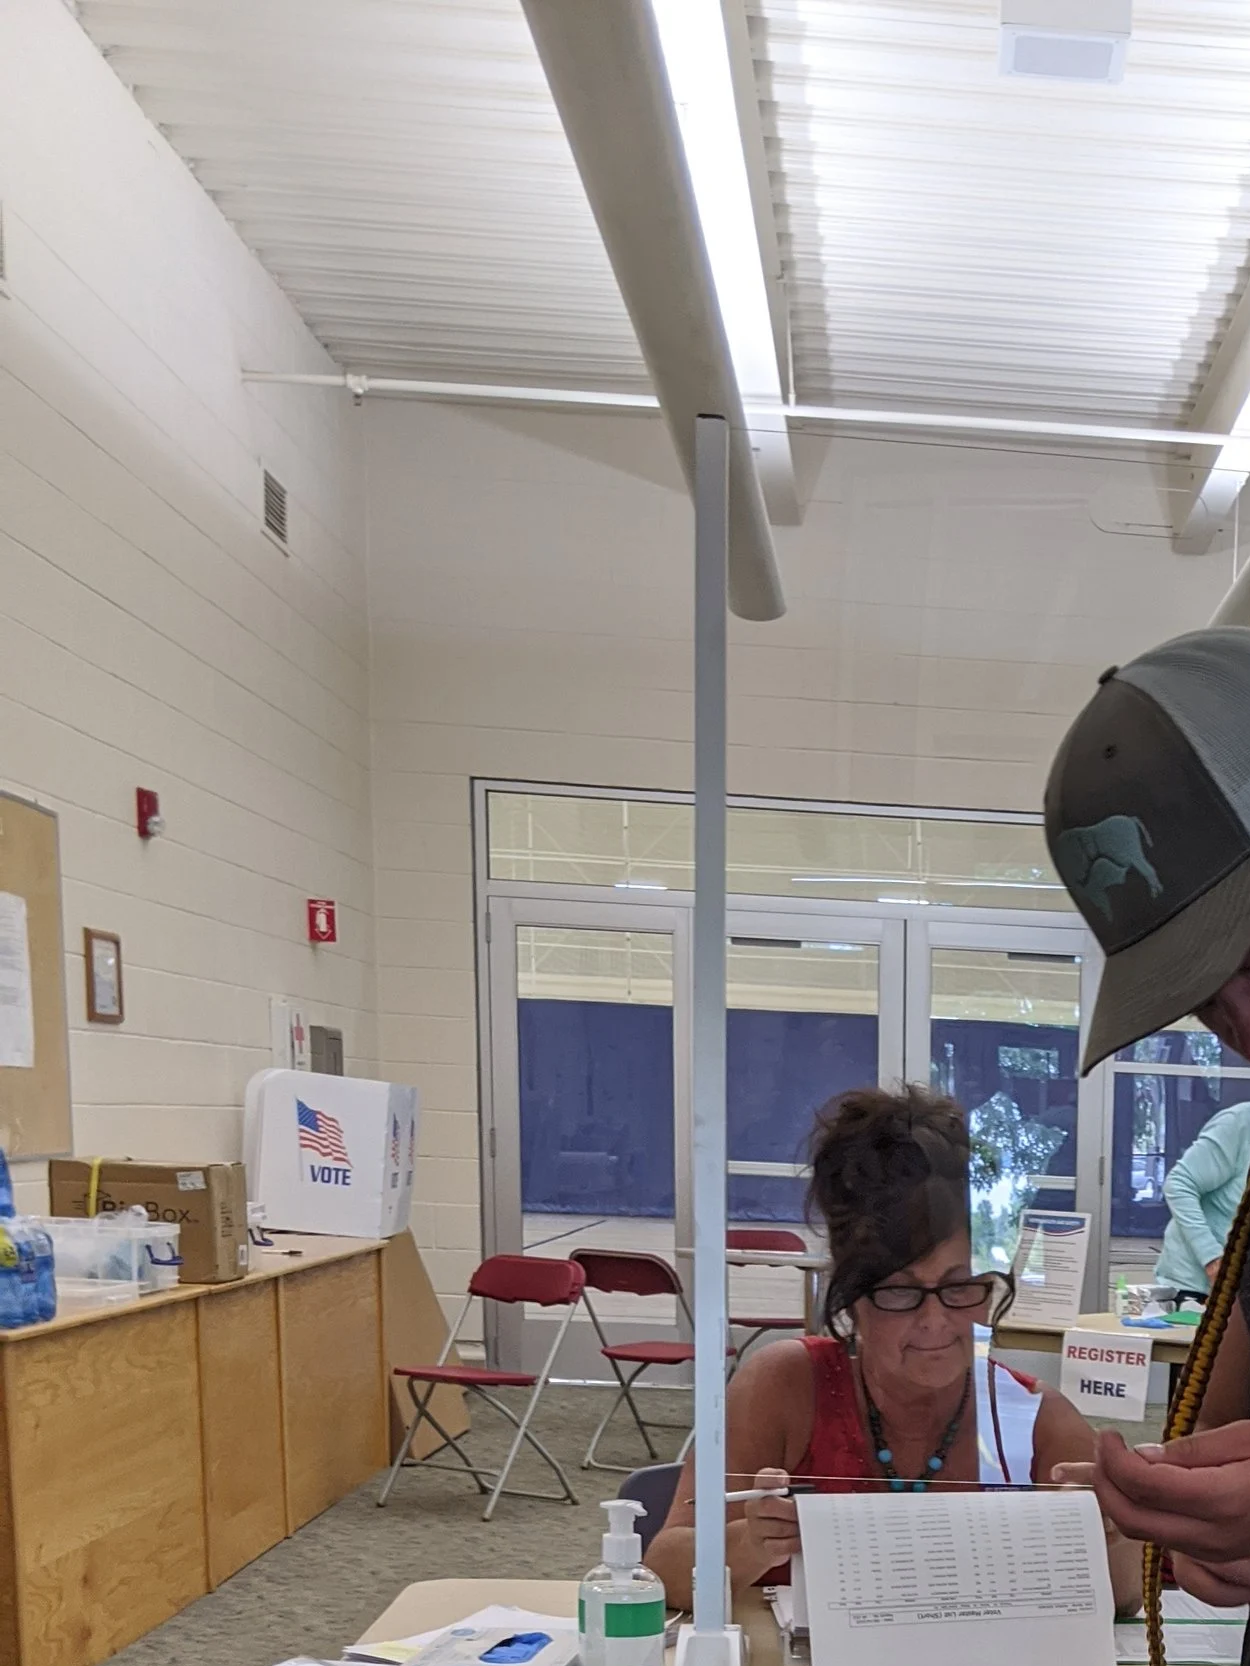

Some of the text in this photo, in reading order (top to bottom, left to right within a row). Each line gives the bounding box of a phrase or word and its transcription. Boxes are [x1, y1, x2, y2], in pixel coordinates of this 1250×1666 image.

[309, 1164, 352, 1186] VOTE
[1067, 1345, 1146, 1367] REGISTER
[1080, 1378, 1127, 1398] HERE
[983, 1609, 1002, 1617] Voter
